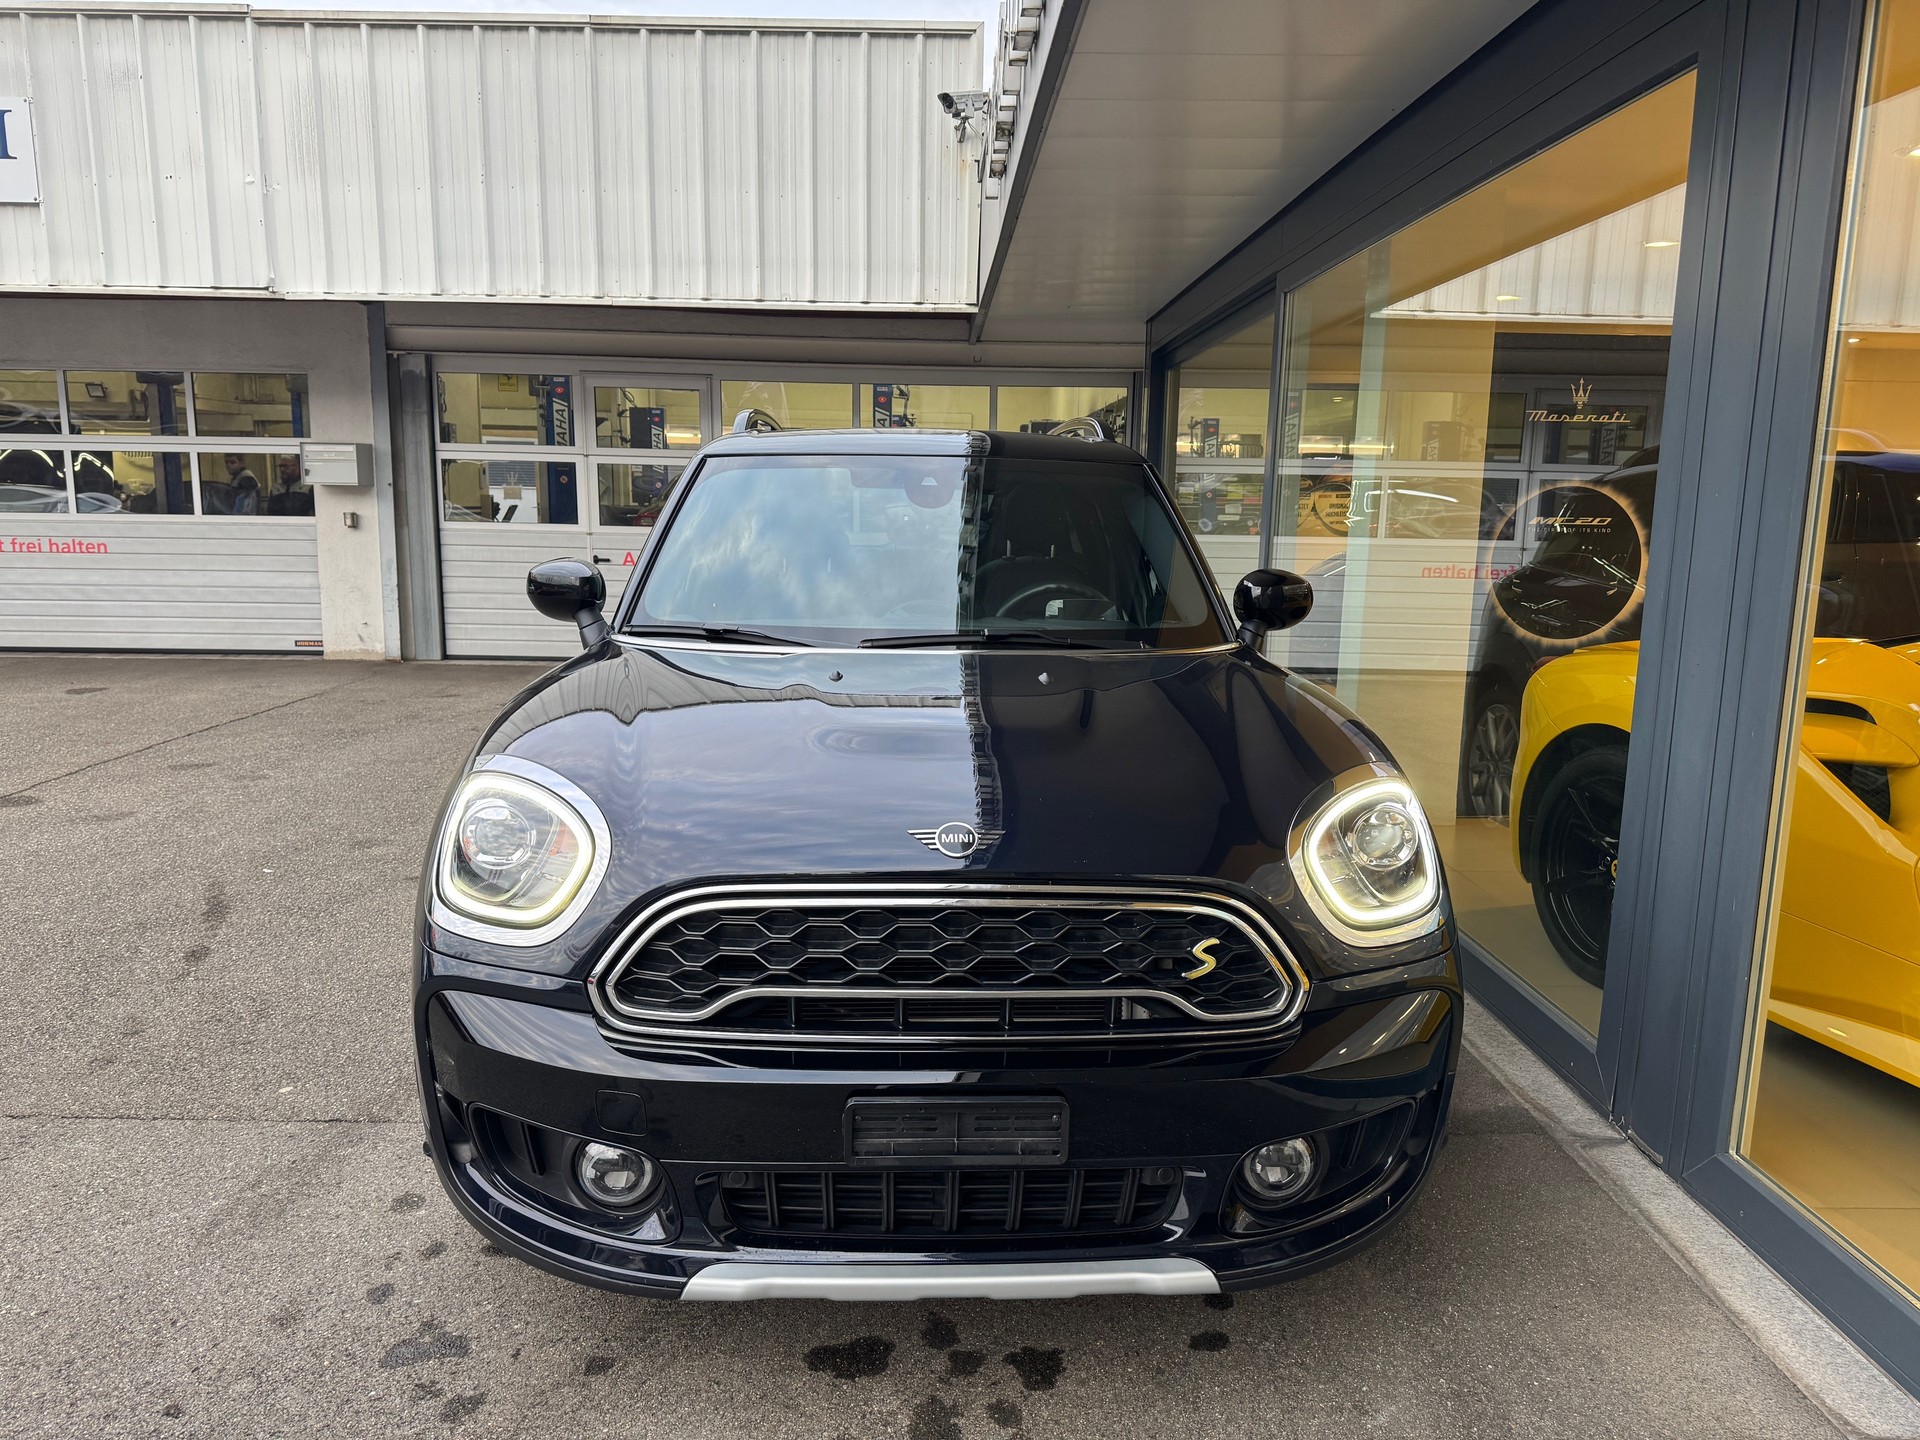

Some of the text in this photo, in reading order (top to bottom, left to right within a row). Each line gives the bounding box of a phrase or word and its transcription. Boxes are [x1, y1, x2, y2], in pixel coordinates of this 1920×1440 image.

[1525, 410, 1631, 423] Maserati
[1528, 516, 1612, 525] MC20
[10, 537, 42, 553] frei
[48, 538, 108, 554] halten
[941, 833, 973, 843] MINI
[1181, 936, 1220, 981] S
